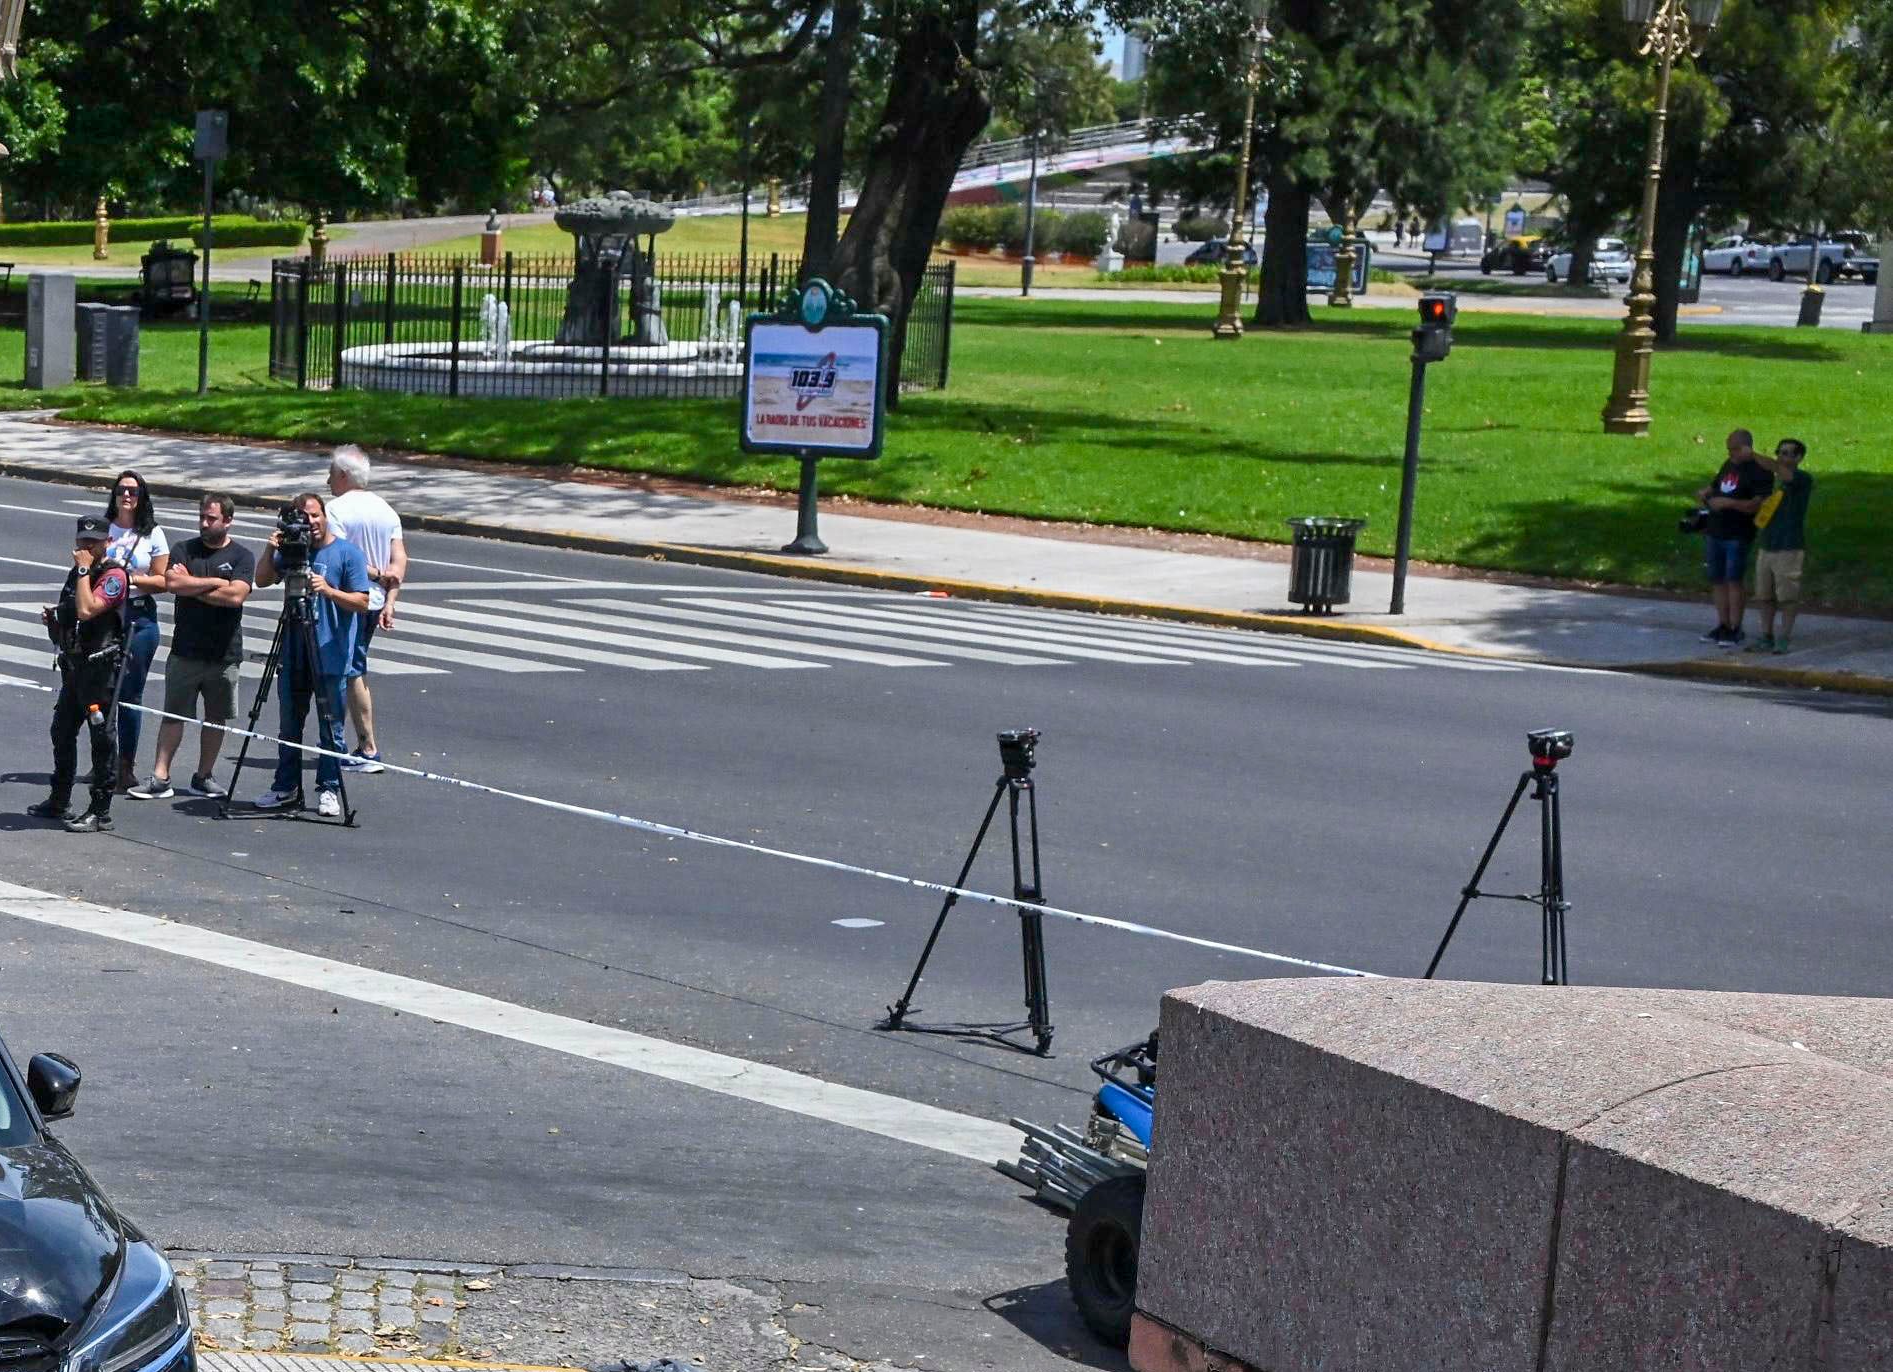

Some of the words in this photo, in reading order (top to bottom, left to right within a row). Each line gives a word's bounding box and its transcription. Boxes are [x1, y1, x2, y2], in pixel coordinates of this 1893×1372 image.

[791, 370, 836, 388] 103.9
[789, 415, 800, 426] DE
[802, 415, 817, 427] TUS
